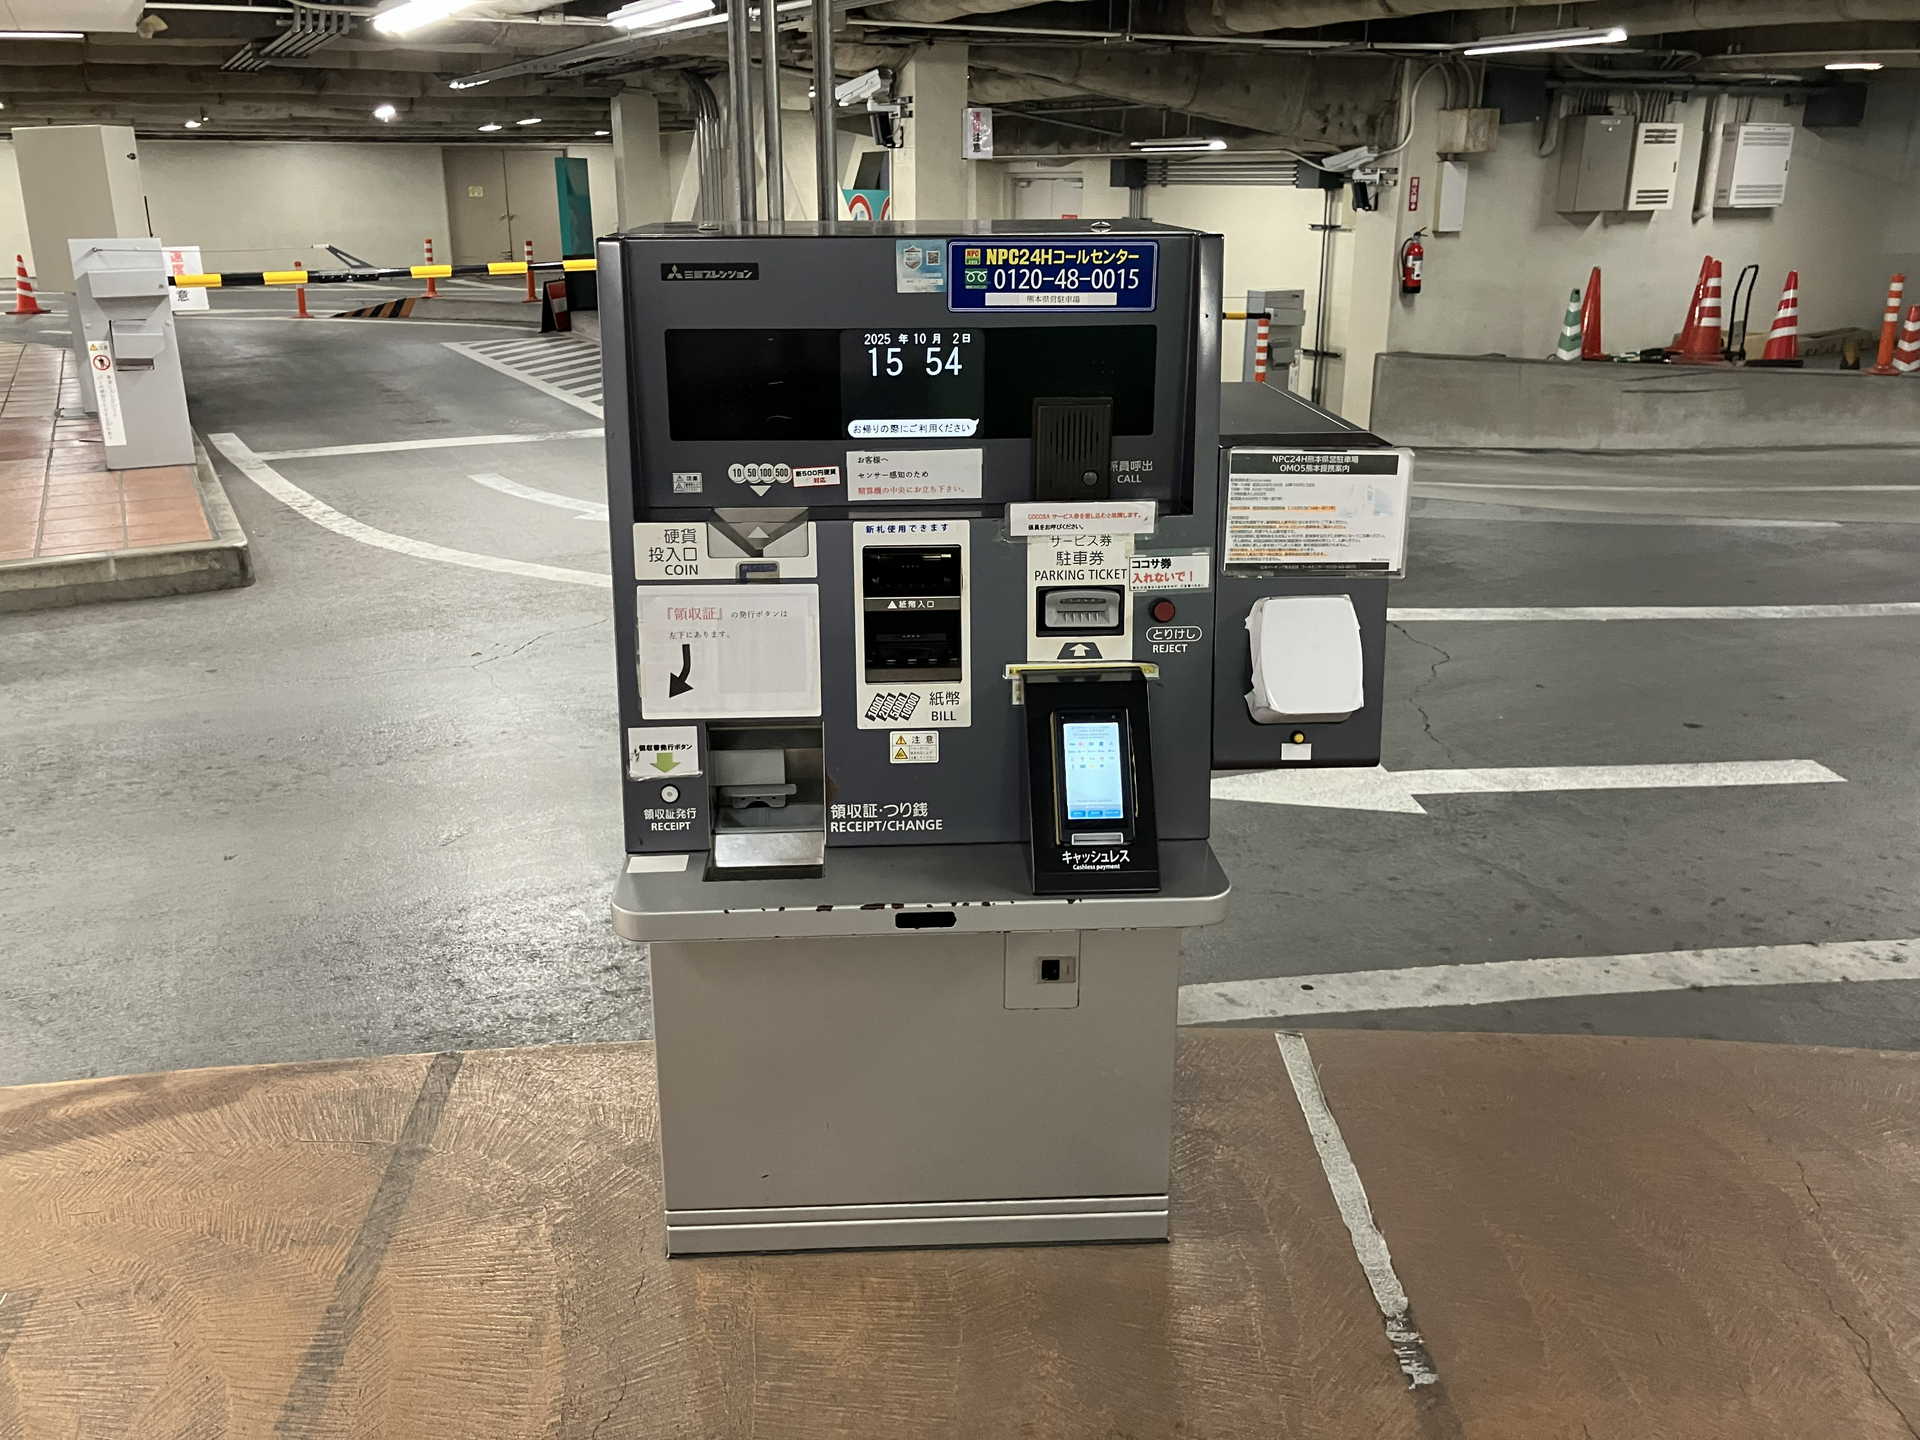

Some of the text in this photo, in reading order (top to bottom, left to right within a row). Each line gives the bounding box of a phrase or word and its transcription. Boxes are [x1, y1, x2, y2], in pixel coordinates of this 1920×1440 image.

[986, 248, 1139, 265] NPC24Hコールセンター
[994, 268, 1139, 290] 0120-48-0015
[864, 333, 891, 345] 2025
[898, 333, 909, 345] 年
[914, 333, 926, 344] 10
[932, 333, 942, 345] 月
[868, 346, 963, 376] 15 54
[857, 456, 889, 464] お客様へ
[733, 468, 742, 477] 10
[747, 468, 757, 477] 50
[760, 468, 772, 477] 100
[775, 467, 789, 477] 500
[857, 471, 929, 479] センサー感知のため
[1117, 474, 1142, 483] CALL
[866, 523, 949, 534] 新札使用できます
[664, 529, 697, 544] 硬貨
[1051, 534, 1112, 548] サービス券
[649, 547, 698, 562] 投入口
[1056, 551, 1105, 566] 駐車券
[665, 564, 699, 576] COIN
[1034, 568, 1128, 581] PARKING TICKET
[669, 631, 730, 640] 左下にあります。
[1153, 630, 1196, 640] とりけし
[1153, 644, 1188, 653] REJECT
[929, 691, 960, 706] 紙幣
[868, 695, 883, 718] 1000
[879, 695, 895, 719] 2000
[890, 694, 906, 719] 5000
[901, 694, 919, 718] 10000
[931, 711, 957, 721] BILL
[644, 808, 697, 819] 領収証発行
[651, 821, 691, 831] RECEIPT
[830, 819, 943, 832] RECEIPT/CHANGE
[1062, 850, 1130, 864] キャッシュレス
[1096, 863, 1121, 871] payment
